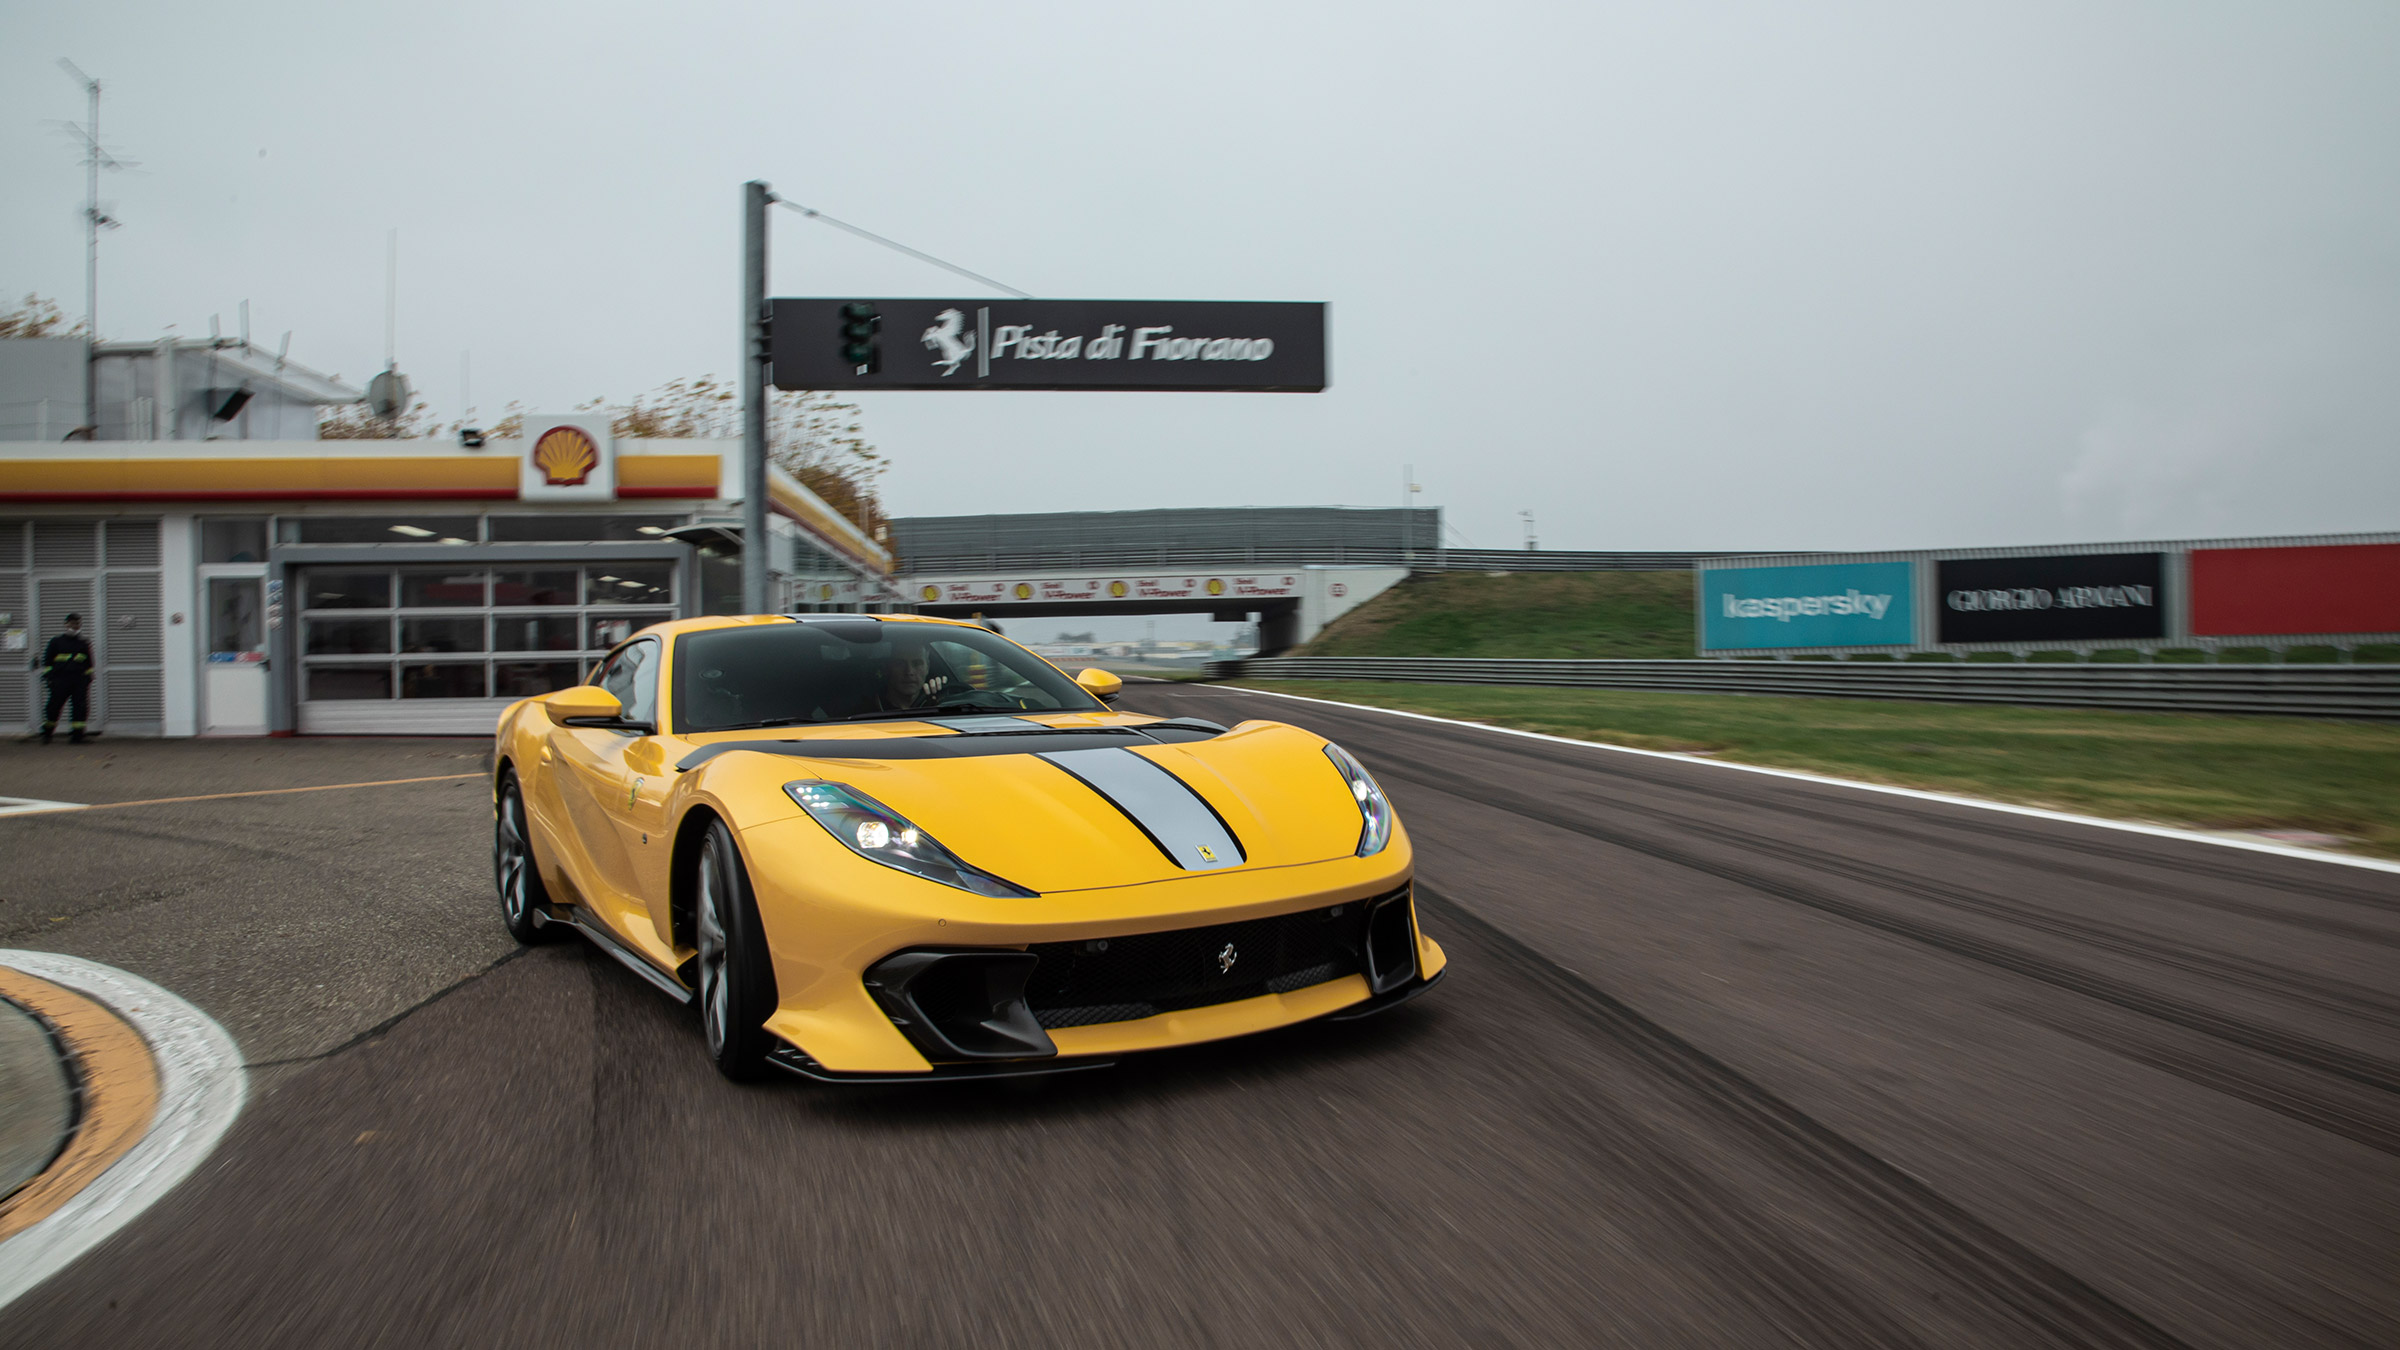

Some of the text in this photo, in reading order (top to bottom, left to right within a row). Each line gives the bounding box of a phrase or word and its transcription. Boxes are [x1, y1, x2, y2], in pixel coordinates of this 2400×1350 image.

[990, 324, 1274, 361] Pista di Fiorano
[1722, 588, 1892, 622] kaspersky
[1947, 584, 2153, 612] GIORGIO ARMANI
